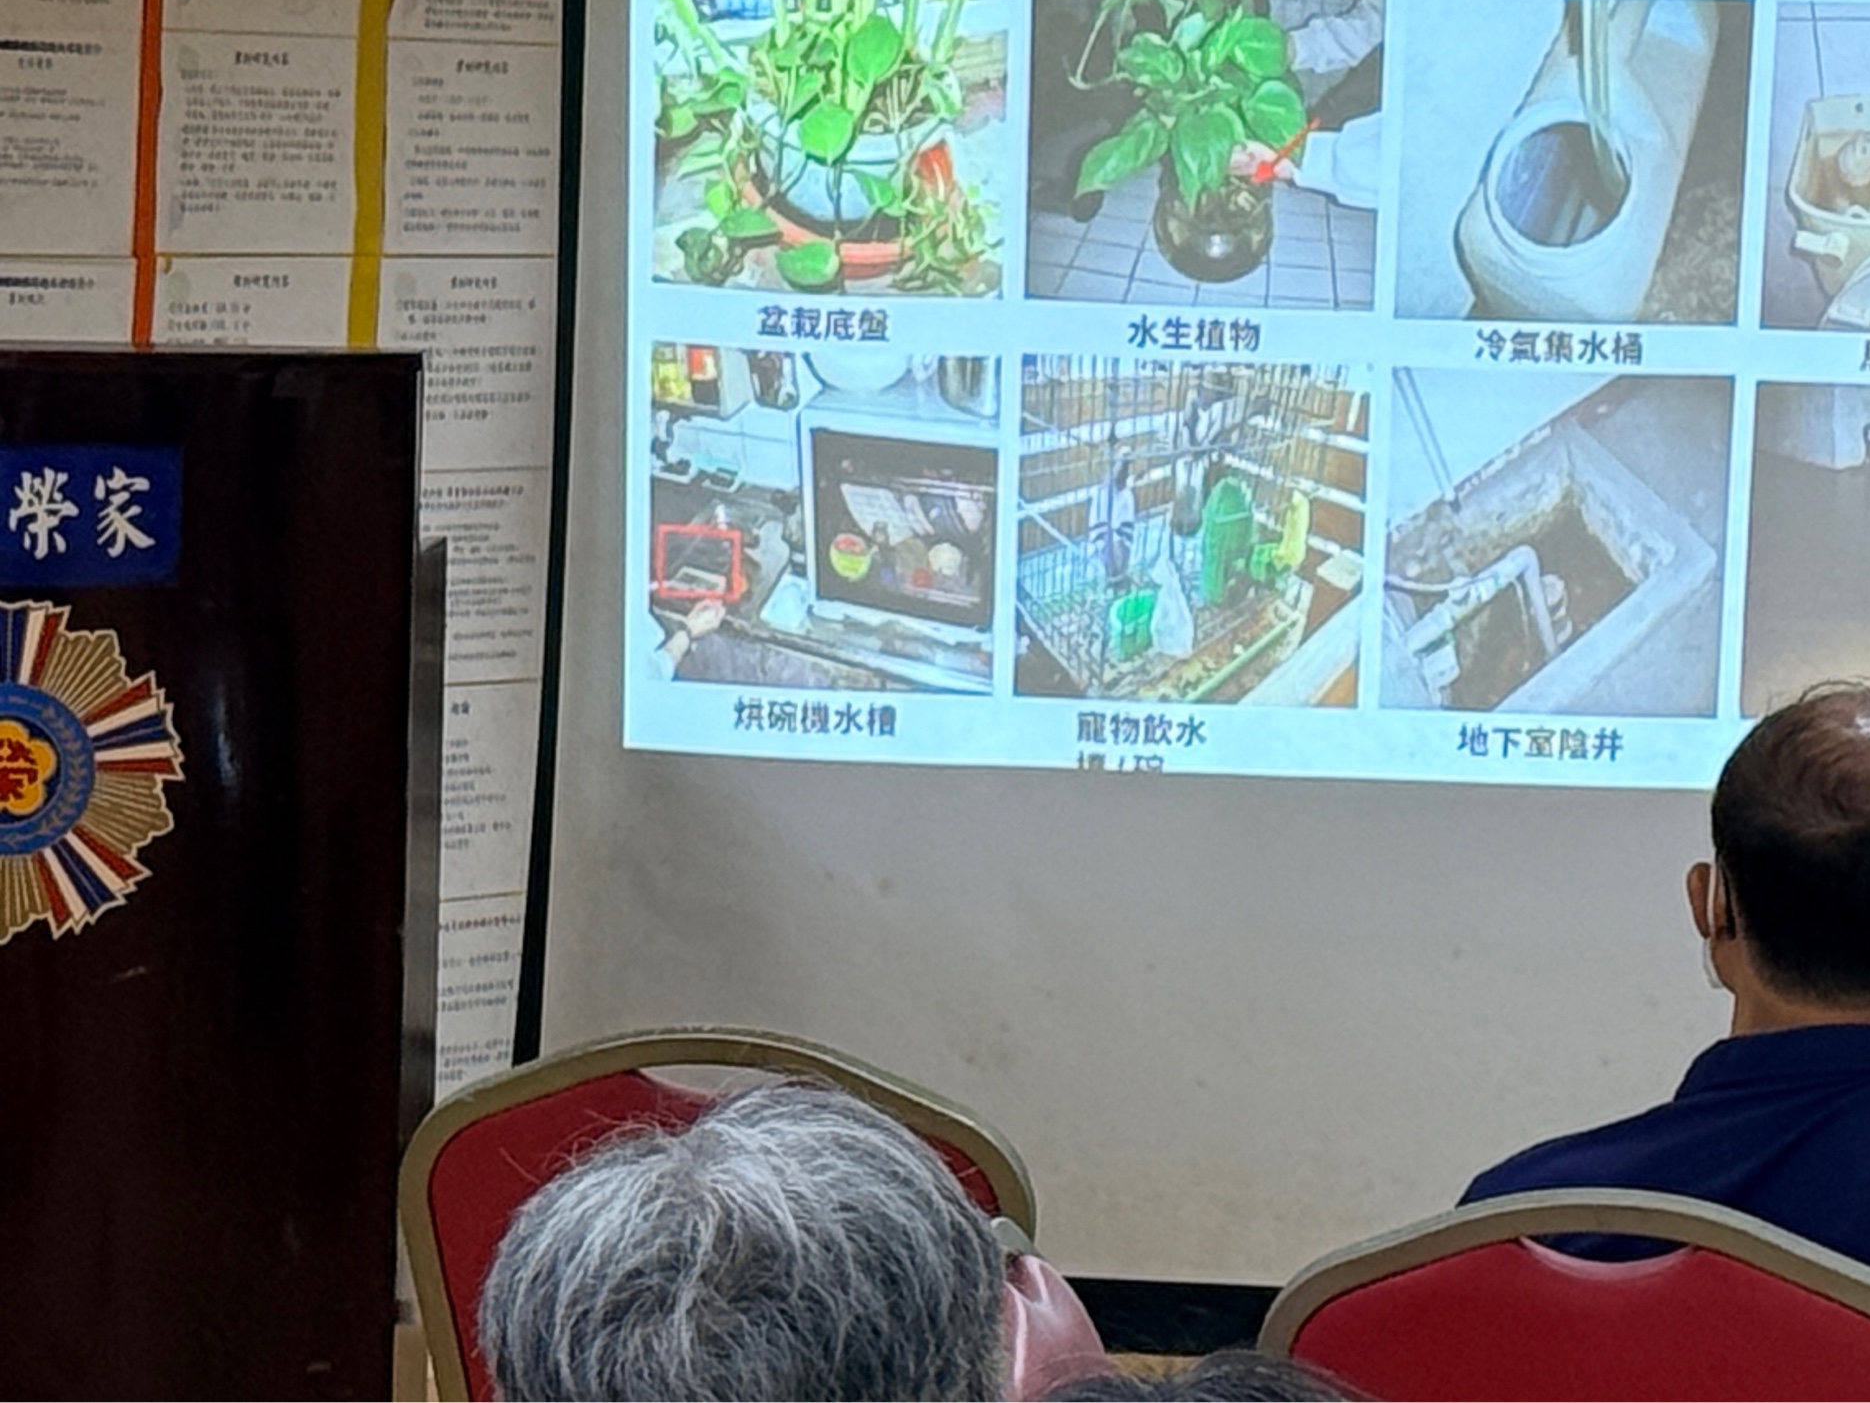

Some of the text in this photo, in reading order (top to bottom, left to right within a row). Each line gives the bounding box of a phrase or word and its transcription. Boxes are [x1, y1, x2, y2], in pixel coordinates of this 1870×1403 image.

[757, 305, 890, 342] 盆栽底盤
[1127, 314, 1261, 352] 水生植物
[1476, 328, 1643, 365] 冷氣集水桶
[8, 465, 156, 561] 榮家
[734, 697, 896, 737] 烘碗機水槽
[1077, 711, 1207, 747] 寵物飲水
[1457, 722, 1624, 762] 地下室陰井
